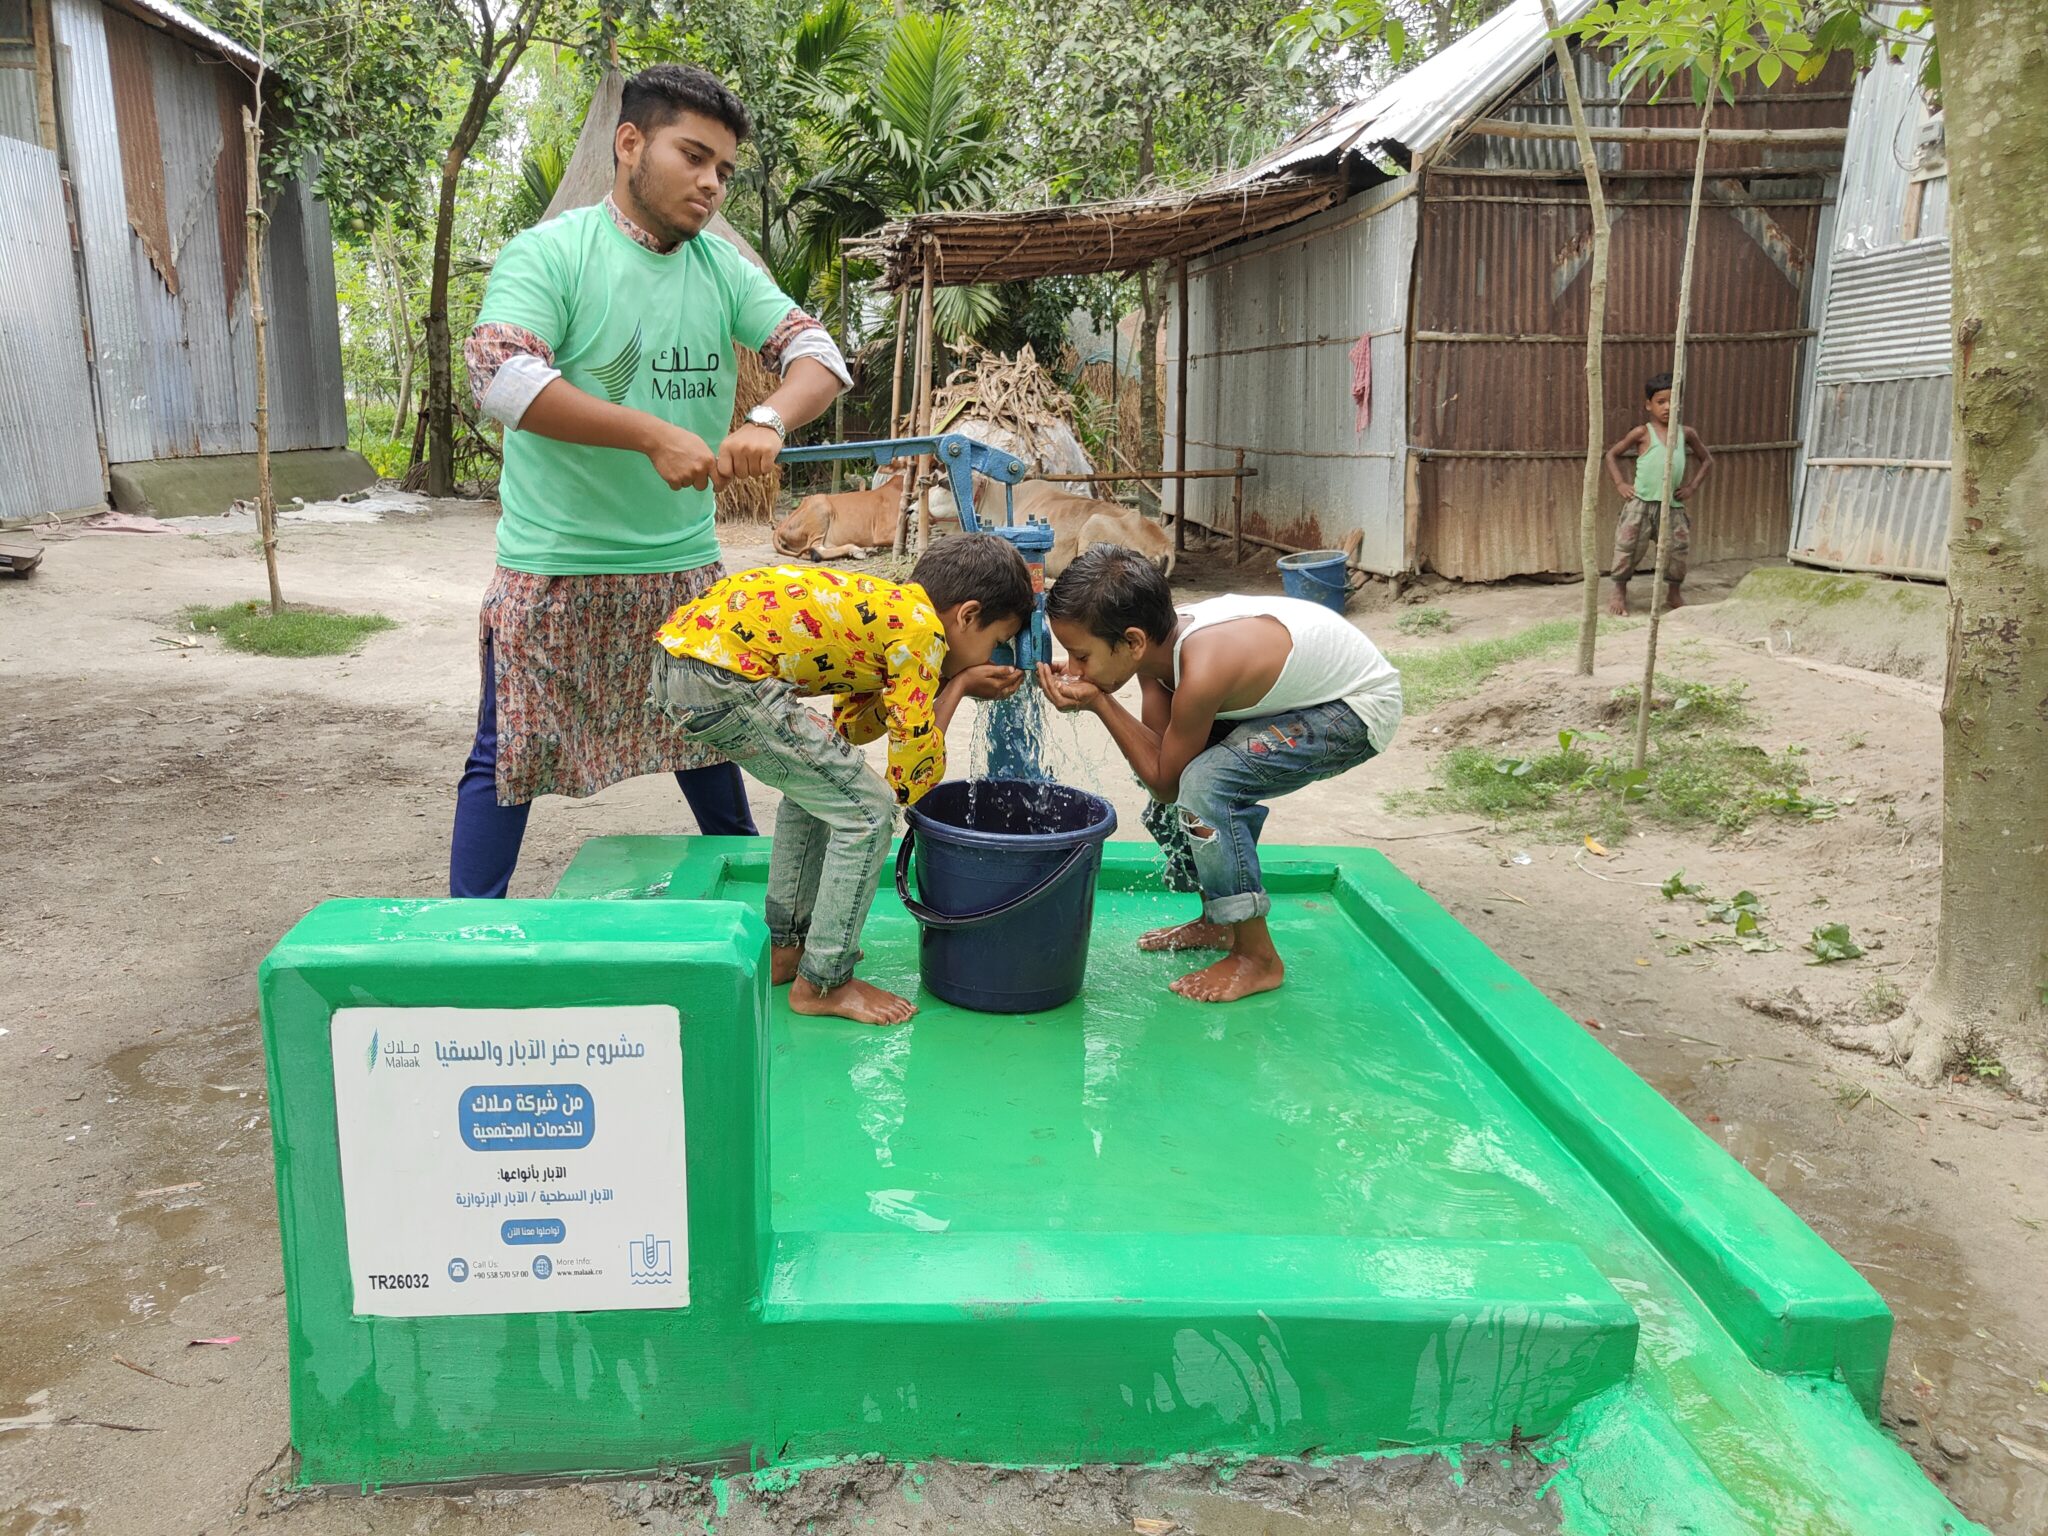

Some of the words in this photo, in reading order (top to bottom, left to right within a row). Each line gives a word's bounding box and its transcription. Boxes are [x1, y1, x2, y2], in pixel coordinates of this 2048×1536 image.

[652, 377, 718, 401] Malaak
[383, 1040, 420, 1054] ملاك
[434, 1040, 503, 1067] والسقيا
[506, 1039, 546, 1066] الآبار
[549, 1038, 580, 1065] حفر
[586, 1033, 645, 1066] مشروع
[385, 1056, 421, 1068] Malaak
[472, 1094, 512, 1112] ملاك
[516, 1089, 558, 1116] شركة
[562, 1094, 583, 1116] من
[473, 1122, 531, 1142] المجتمعية
[533, 1121, 583, 1138] للخدمات
[543, 1166, 567, 1182] الآبار
[504, 1191, 528, 1207] الآبار
[540, 1190, 587, 1205] السطحية
[590, 1189, 614, 1204] الآبار
[536, 1226, 561, 1237] تواصلوا
[472, 1261, 486, 1269] Call
[556, 1258, 575, 1266] More
[368, 1273, 430, 1290] TR26032
[473, 1271, 486, 1279] +90
[486, 1271, 499, 1279] 538
